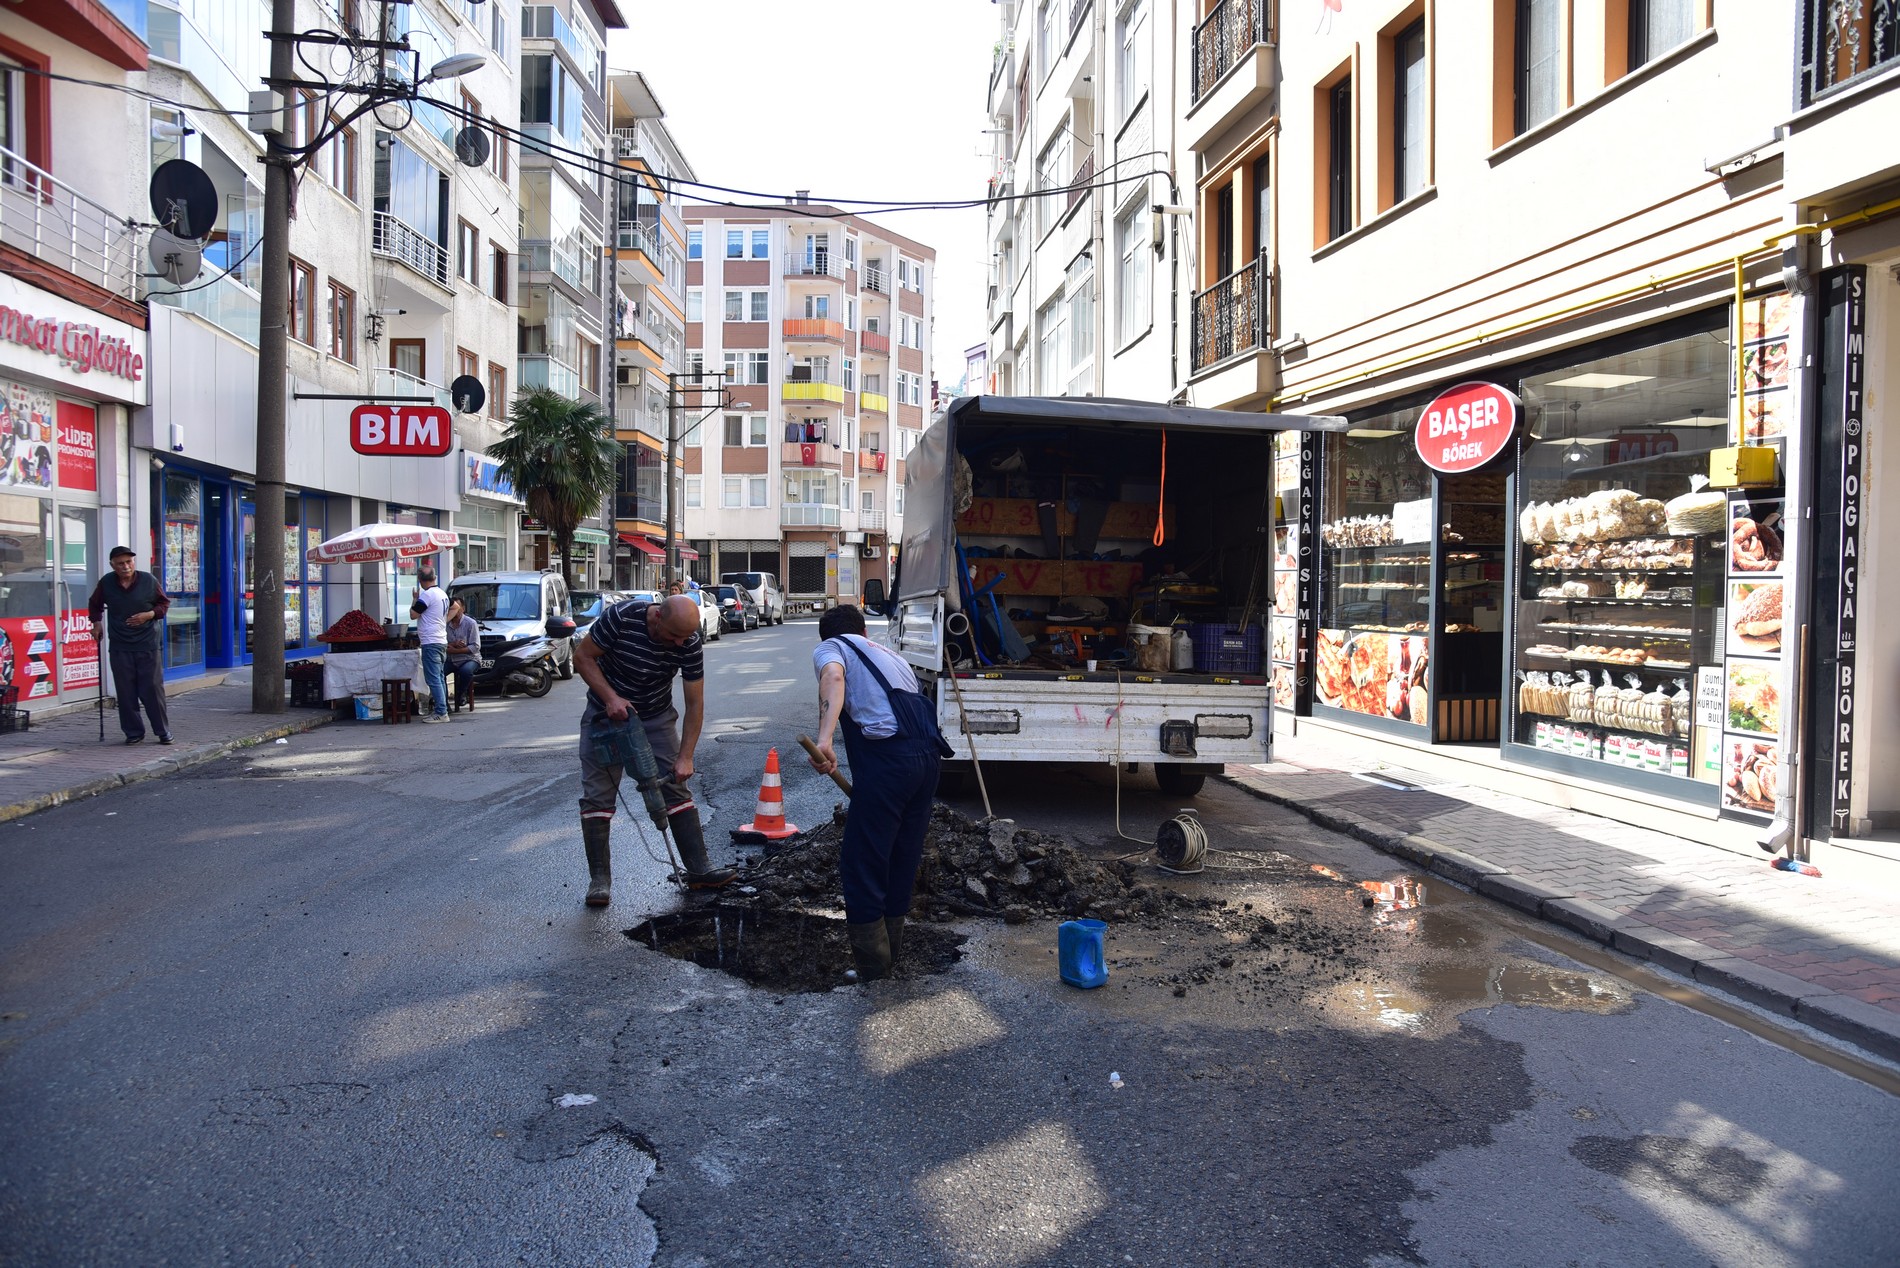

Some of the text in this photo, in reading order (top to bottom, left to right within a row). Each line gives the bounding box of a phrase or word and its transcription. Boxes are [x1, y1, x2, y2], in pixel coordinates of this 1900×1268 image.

[65, 425, 94, 449] LİDER
[360, 407, 440, 446] BİM
[1429, 397, 1499, 440] BAŞER
[1442, 442, 1482, 463] BÖREK
[1298, 431, 1312, 663] POĞAÇA SİMİT
[1838, 276, 1863, 799] SİMİT POĞAÇA BÖREK
